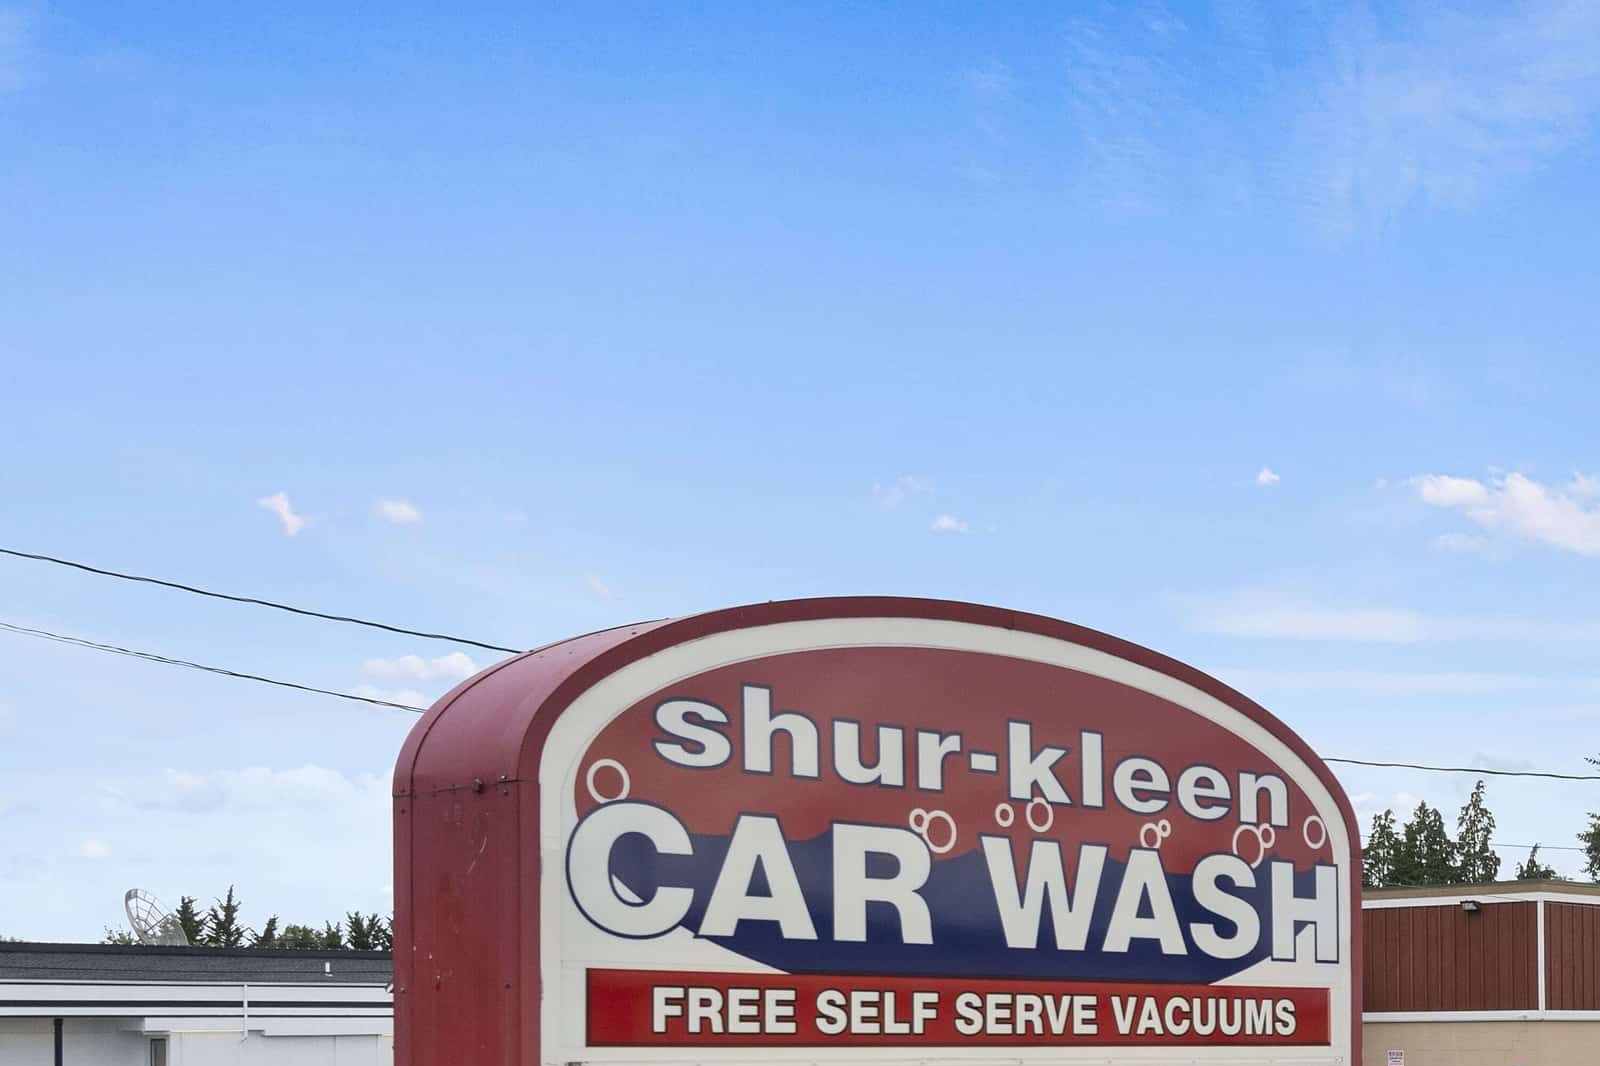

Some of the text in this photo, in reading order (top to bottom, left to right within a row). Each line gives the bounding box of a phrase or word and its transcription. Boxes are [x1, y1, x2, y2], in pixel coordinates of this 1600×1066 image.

[652, 683, 1290, 828] shur-kleen
[565, 799, 1340, 965] CAR WASH
[652, 985, 1298, 1038] FREE SELF SERVE VACUUMS
